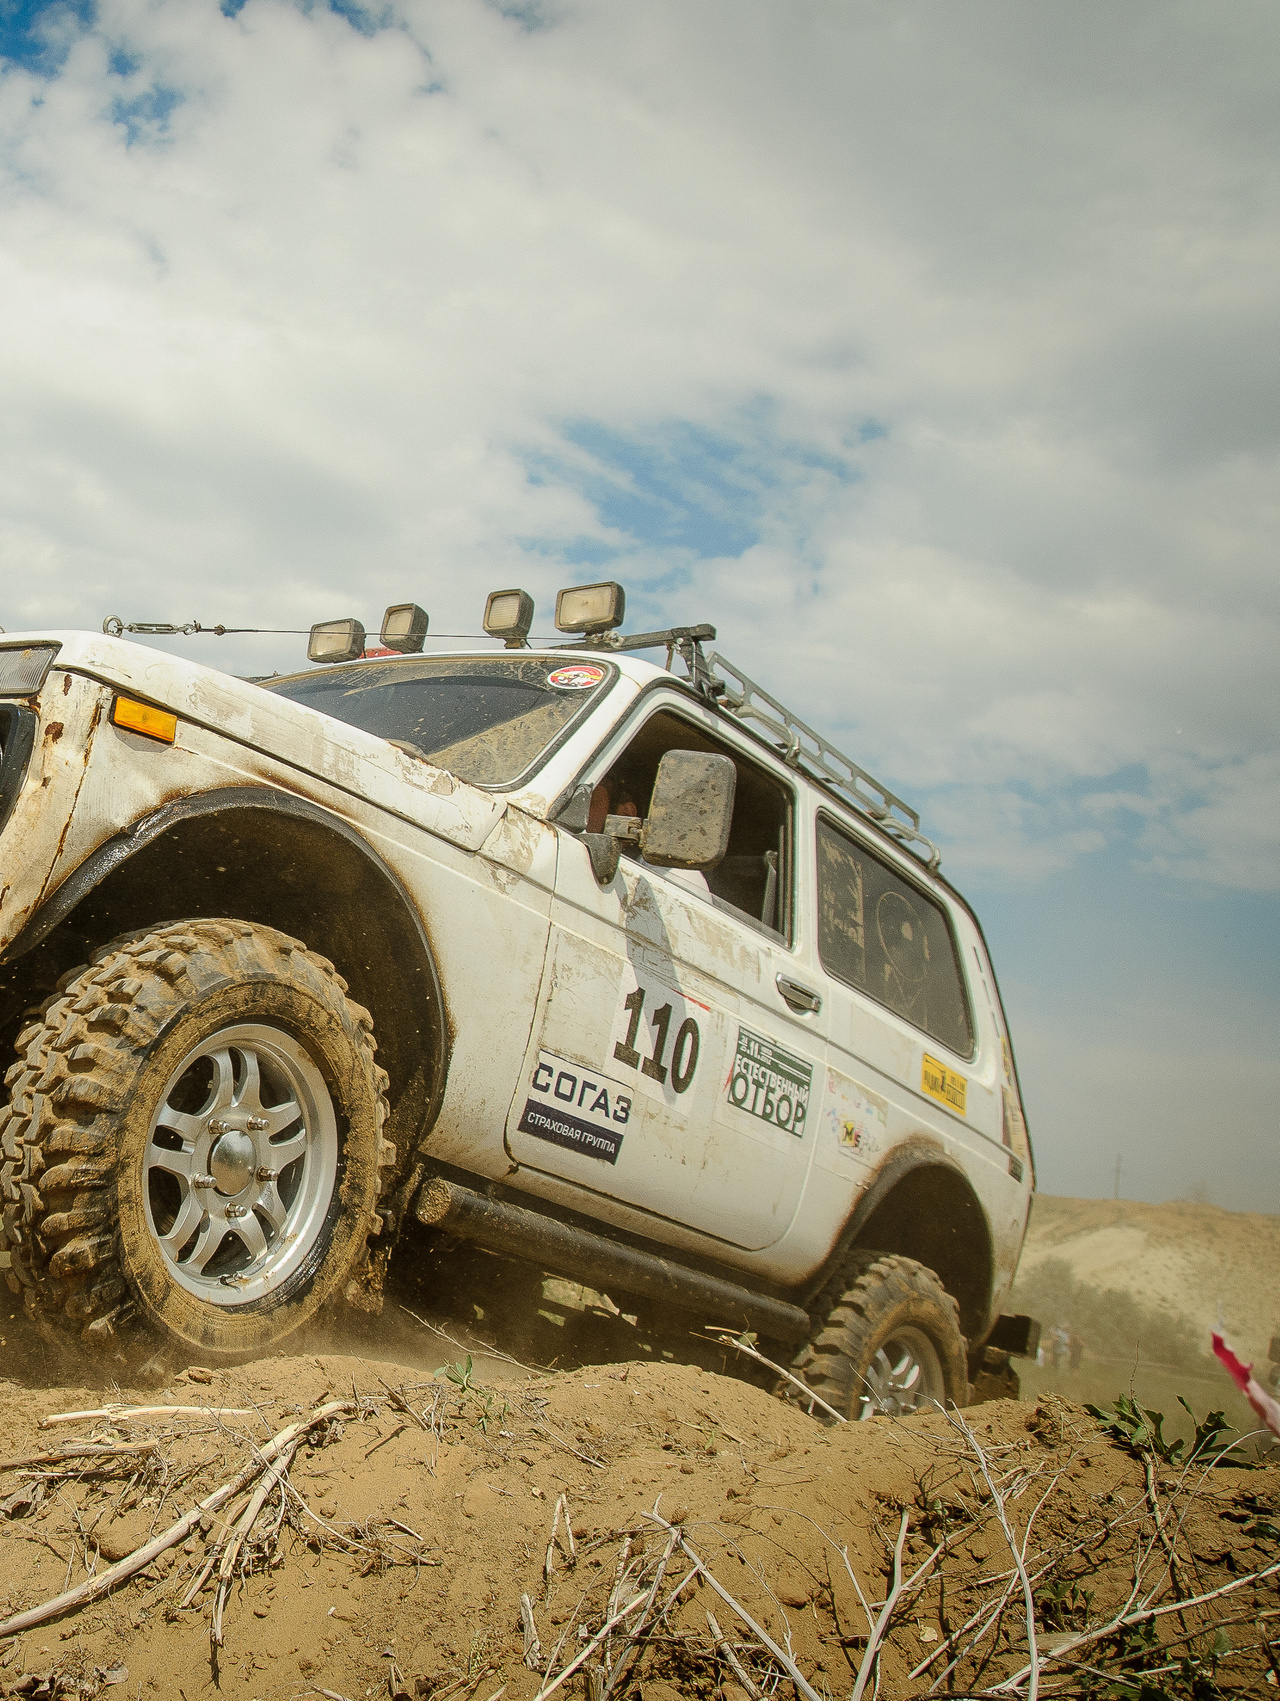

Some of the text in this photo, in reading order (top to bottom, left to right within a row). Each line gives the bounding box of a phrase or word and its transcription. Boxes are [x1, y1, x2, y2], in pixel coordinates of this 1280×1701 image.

[613, 986, 700, 1094] 110
[532, 1062, 632, 1124] СОГАЗ
[731, 1072, 807, 1133] ОТБОР
[734, 1053, 809, 1105] ЕСТЕСТВЕННЫЙ
[527, 1112, 616, 1154] СТРАХОВАЯ ГРУППА
